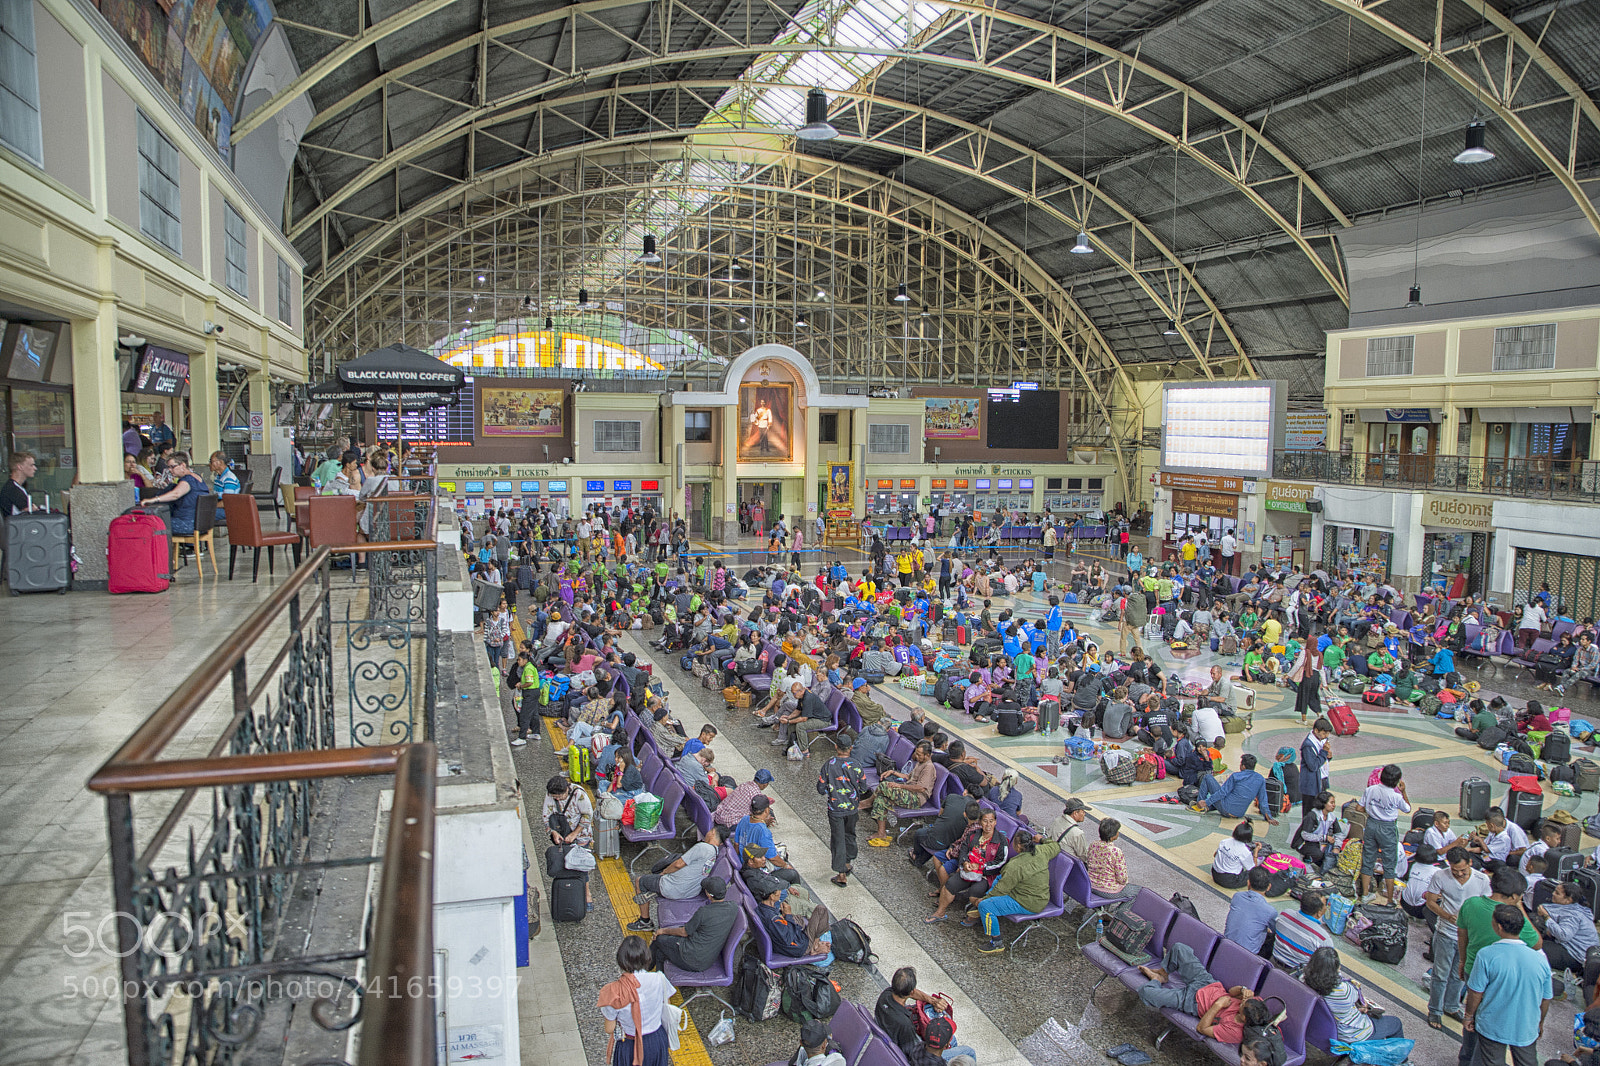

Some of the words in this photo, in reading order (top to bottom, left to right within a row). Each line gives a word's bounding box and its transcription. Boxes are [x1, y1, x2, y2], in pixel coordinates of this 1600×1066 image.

[152, 356, 170, 375] BLACK
[347, 371, 378, 379] BLACK
[378, 371, 418, 380] CANYON
[419, 371, 457, 382] COFFEE
[156, 376, 177, 392] COFFEE
[516, 468, 549, 477] TICKETS
[1271, 485, 1313, 500] ศูนย์อาหา
[1191, 504, 1204, 512] Train
[1430, 499, 1493, 516] ศูนย์อาหาร
[1440, 516, 1460, 525] FOOD
[1462, 518, 1489, 528] COURT
[901, 651, 908, 664] 9
